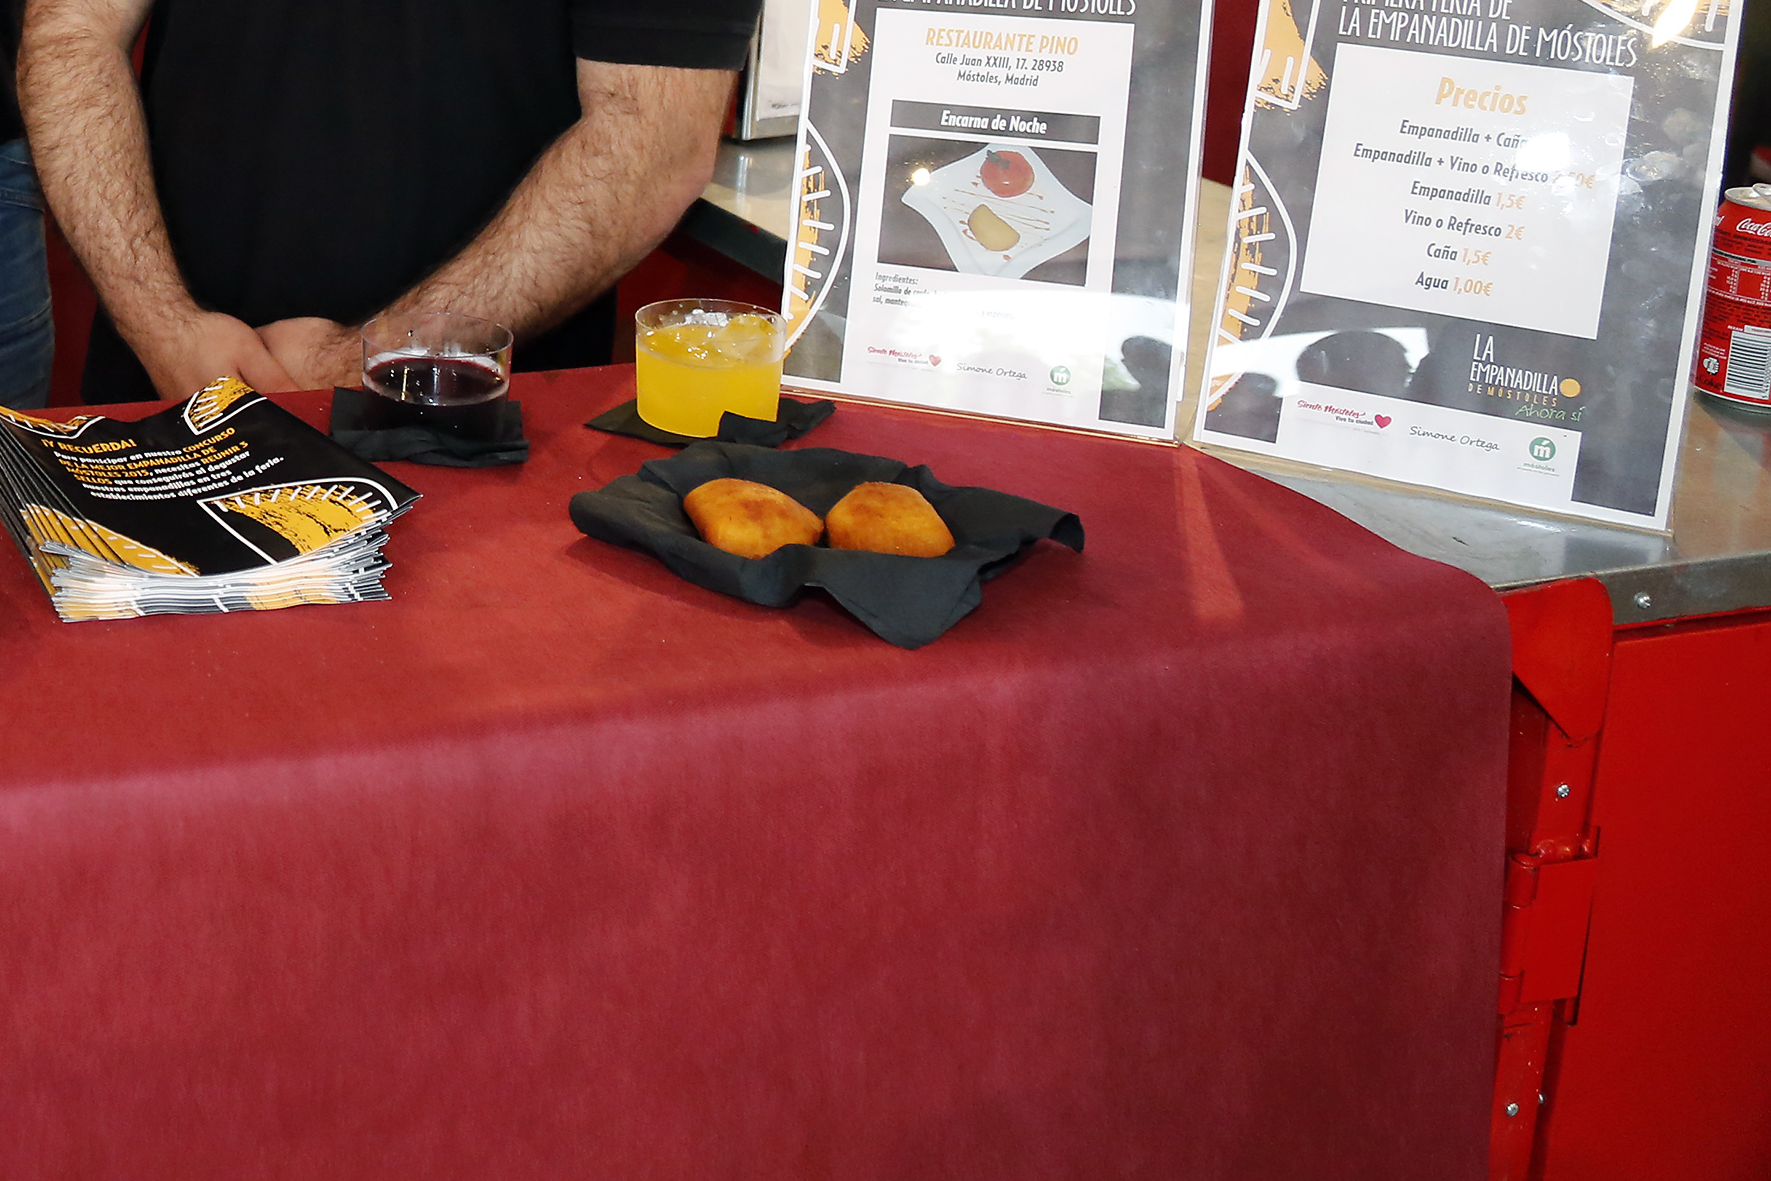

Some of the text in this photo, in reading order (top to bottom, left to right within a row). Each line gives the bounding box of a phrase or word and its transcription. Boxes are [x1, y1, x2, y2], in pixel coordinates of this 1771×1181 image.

[925, 27, 1079, 55] RESTAURANTE PINO
[1338, 5, 1638, 68] LA EMPANADILLA DE MÓSTOLES
[935, 52, 1064, 73] Calle Juan XXIII, 17. 28938
[956, 71, 1039, 87] Móstoles, Madrid
[1435, 77, 1529, 116] Precios
[940, 110, 1047, 135] Encarna de Noche
[1399, 119, 1480, 145] Empanadilla
[1353, 143, 1549, 184] Empanadilla Vino o Refresco
[1410, 180, 1525, 211] Empanadilla 1,5€
[1403, 209, 1524, 241] Vino o Refresco 2€
[1426, 242, 1491, 266] Caña 1,5€
[875, 272, 919, 285] Ingredientes:
[1415, 271, 1493, 297] Agua 1,00€
[1473, 334, 1494, 362] LA
[957, 363, 1027, 380] Simone Ortega
[1470, 361, 1558, 395] EMPANADILLA
[1468, 383, 1482, 394] DE
[1515, 404, 1585, 421] Ahora sí
[57, 439, 137, 454] RECUERDA!
[144, 450, 182, 459] nuestro
[183, 427, 235, 453] CONCURSO
[1410, 425, 1500, 451] Simone Ortega
[74, 475, 112, 485] SELLOS
[135, 471, 194, 484] conseguirás
[196, 467, 206, 475] al
[208, 451, 250, 471] degustar
[90, 463, 124, 471] MEJOR
[127, 455, 201, 469] EMPANADILLA
[201, 446, 217, 455] DE
[154, 461, 200, 474] necesitas
[201, 445, 240, 464] REUNIR
[90, 456, 284, 500] establecimientos diferentes de la feria.
[128, 479, 196, 493] empanadillas
[211, 469, 232, 481] tres
